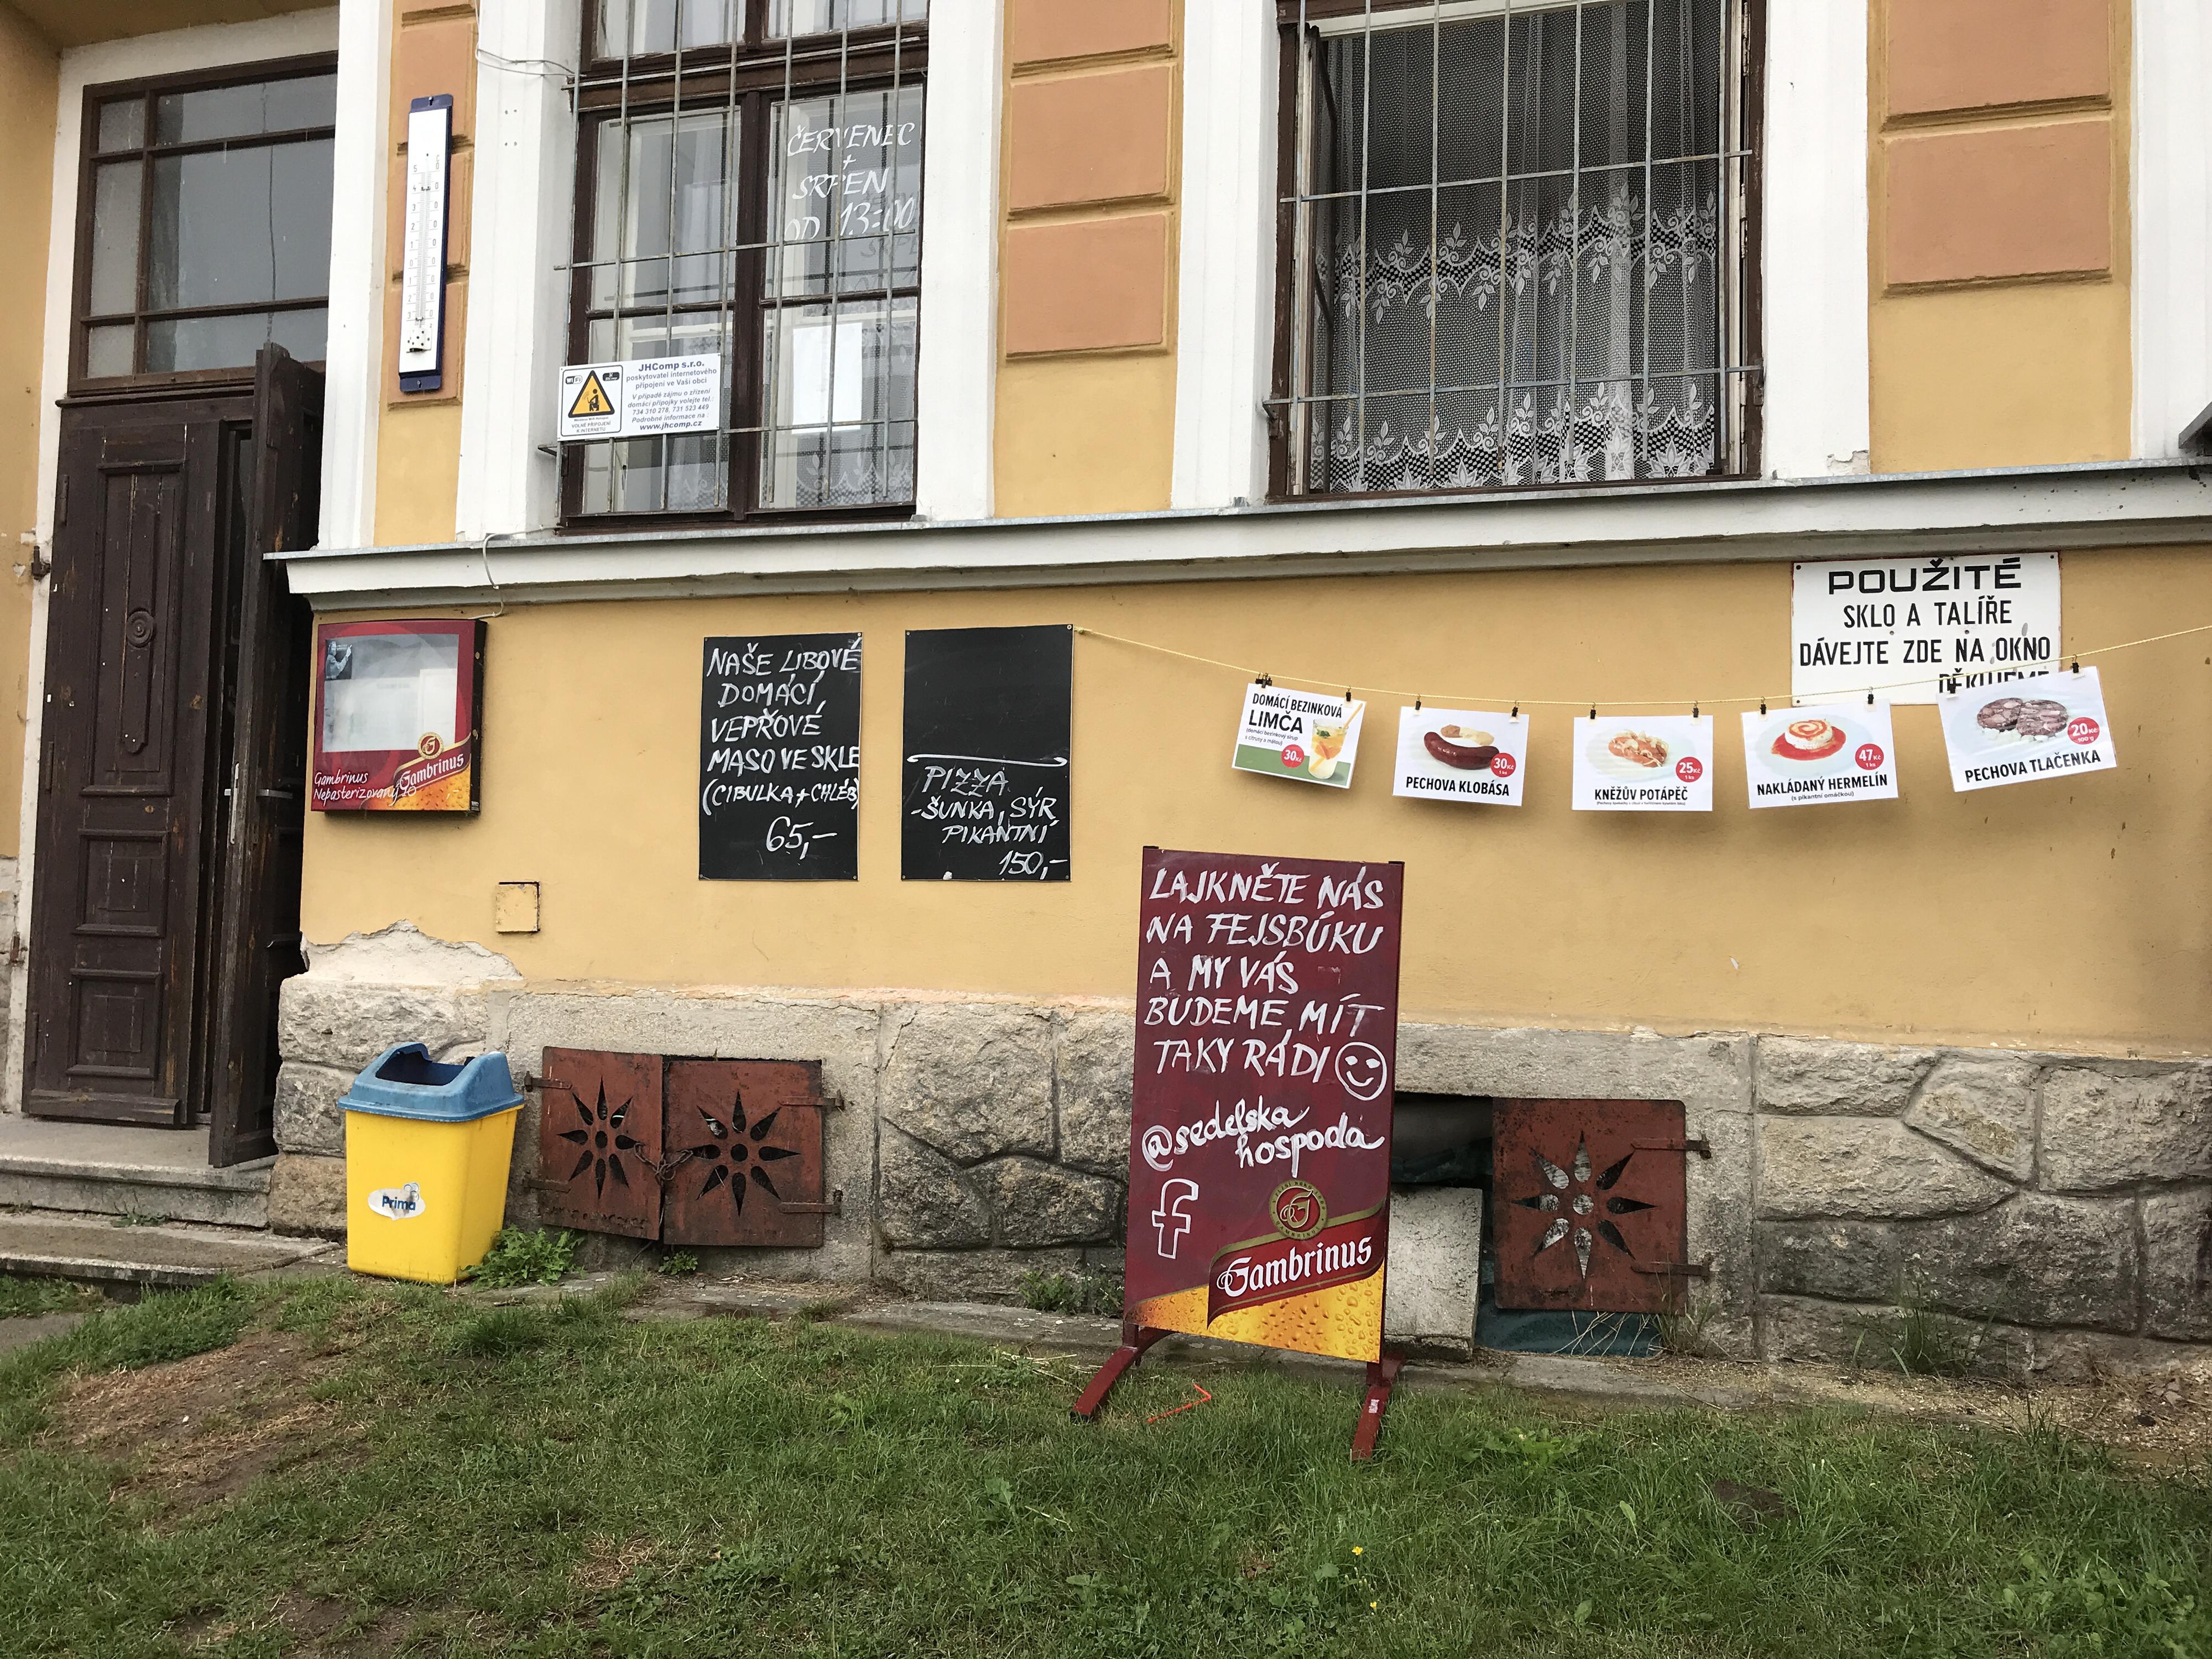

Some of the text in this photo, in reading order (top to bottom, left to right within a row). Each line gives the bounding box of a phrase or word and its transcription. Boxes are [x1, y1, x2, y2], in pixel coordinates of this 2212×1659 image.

[792, 166, 890, 200] SRPEN
[626, 368, 717, 383] poskytovatel internetového
[639, 363, 679, 372] JHComp
[635, 381, 665, 390] připojení
[680, 397, 701, 405] volejte
[640, 421, 702, 430] www.jhcomp.cz
[1828, 557, 2022, 594] POUŽITÉ
[1844, 596, 2012, 628] SKLO A TALÍŘE
[706, 637, 863, 677] NAŠE LIBOVÉ
[1799, 637, 2051, 666] DÁVEJTE ZDE NA OKNO
[718, 671, 825, 707] DOMÁCÍ
[712, 700, 826, 743] VEPŘOVÉ
[1249, 709, 1303, 734] LIMČA
[1252, 693, 1343, 718] DOMÁCÍ BEZINKOVÁ
[395, 753, 465, 791] Gambrinus
[707, 745, 859, 776] MASO VE SKLE
[1965, 749, 2101, 782] PECHOVA TLAČENKA
[314, 769, 368, 787] Gambrinus
[922, 765, 1009, 797] PIZZA
[1406, 776, 1509, 796] PECHOVA KLOBÁSA
[1595, 786, 1688, 800] KNĚŽŮV POTÁPĚČ
[1757, 771, 1887, 796] NAKLÁDANÝ HERMELÍN
[1010, 787, 1057, 821] SÝR
[942, 820, 1060, 844] PIKANTNÍ
[1149, 862, 1384, 910] LAJKNĚTE NÁS
[1146, 911, 1384, 954] NA FEJSBÚKU
[1150, 951, 1299, 994] A MY VÁS
[1144, 993, 1385, 1037] BUDEME MÍT
[1154, 1029, 1331, 1083] TAKY RÁDI
[1141, 1095, 1310, 1172] @sedelska
[1235, 1112, 1385, 1178] hospoda
[382, 1196, 416, 1211] Prima
[1217, 1237, 1372, 1297] Gambrinus
